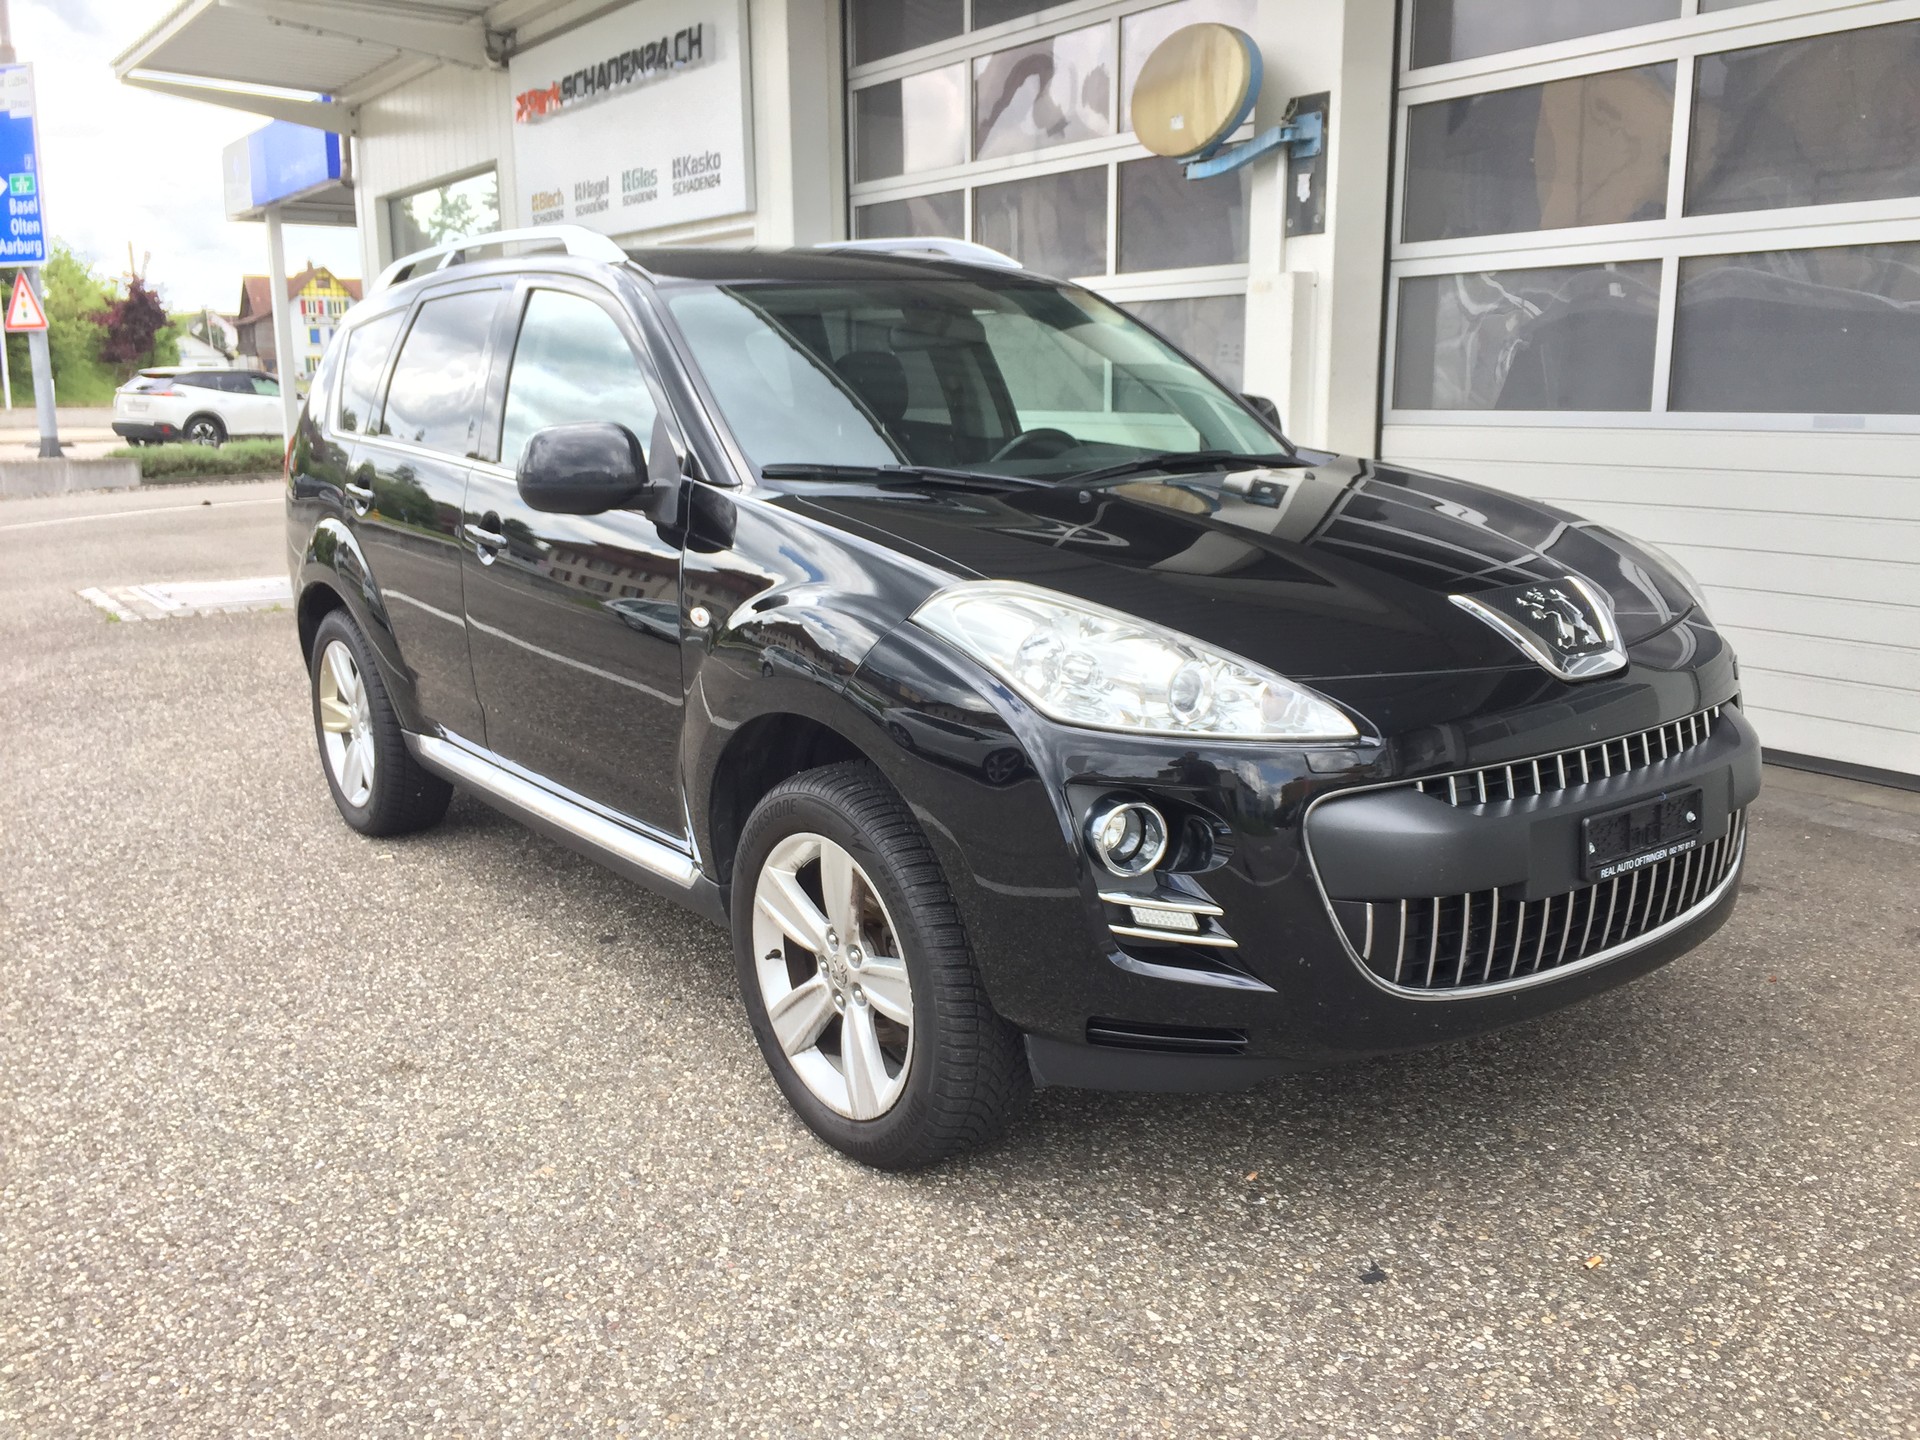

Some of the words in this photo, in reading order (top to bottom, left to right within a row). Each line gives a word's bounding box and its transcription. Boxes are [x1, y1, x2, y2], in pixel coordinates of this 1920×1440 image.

[682, 150, 721, 176] Kasko
[583, 176, 610, 201] Hagel
[631, 168, 658, 190] Glas
[9, 196, 39, 216] Basel
[538, 190, 565, 211] Blech
[10, 217, 40, 236] Olten
[0, 237, 43, 258] Aarburg
[1601, 867, 1616, 878] REAL
[1617, 860, 1634, 873] AUTO
[1635, 849, 1667, 867] OFTRINGEN
